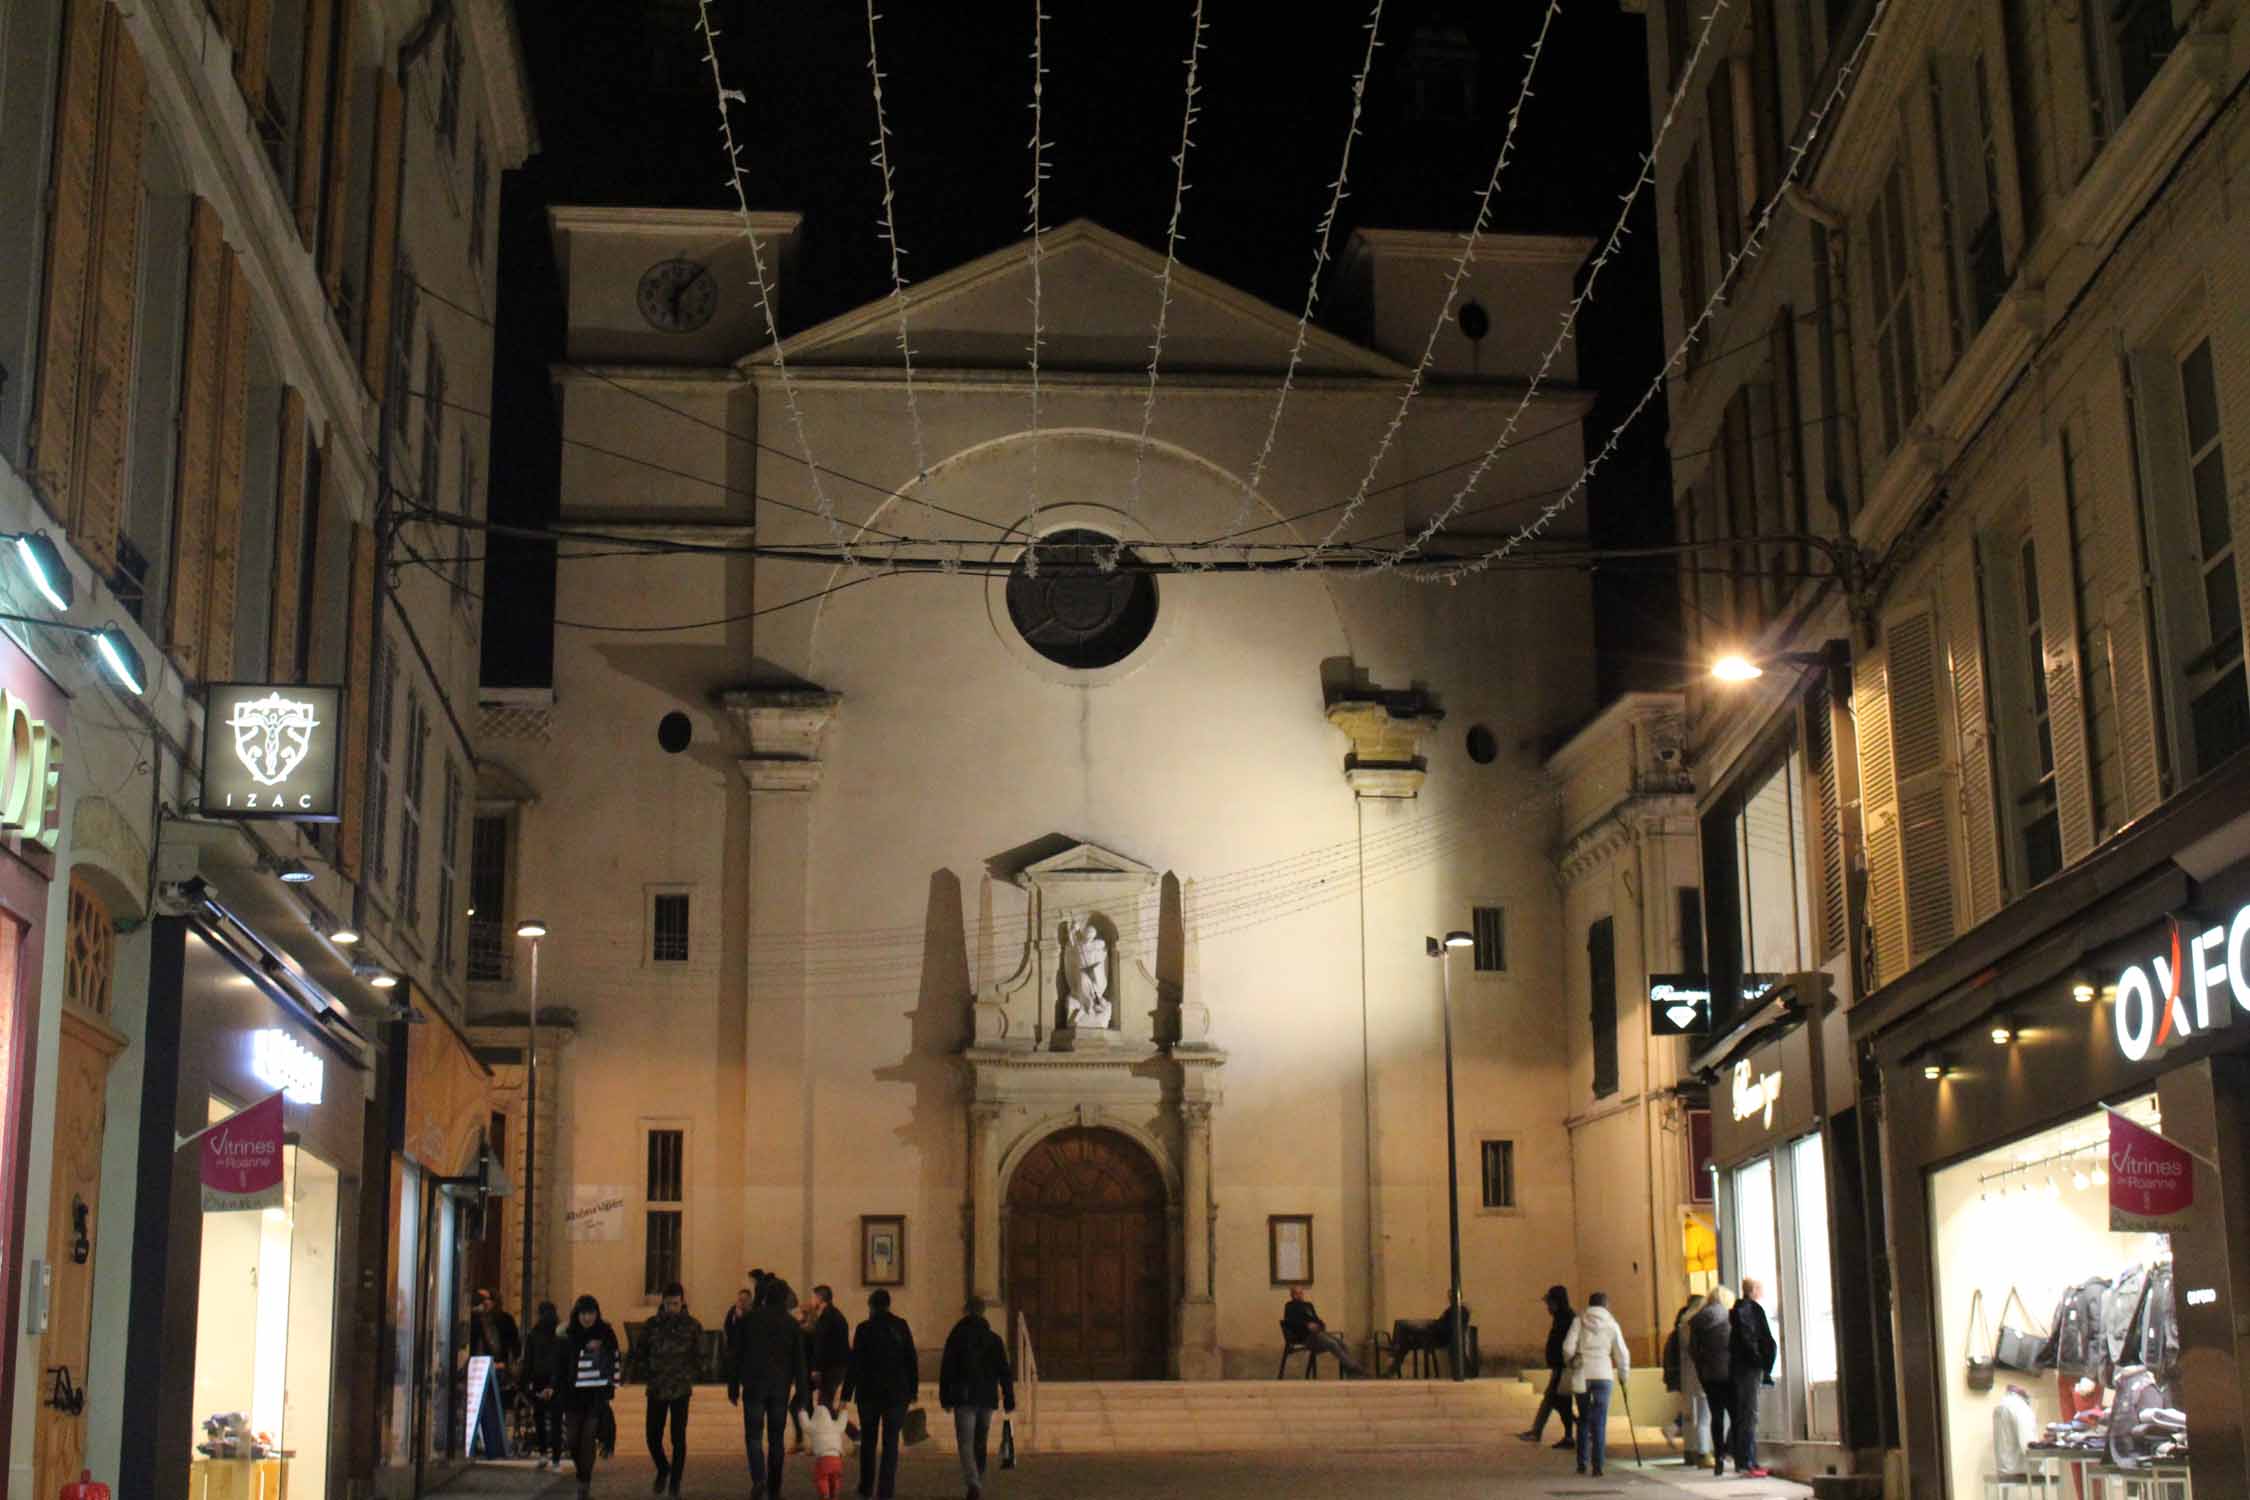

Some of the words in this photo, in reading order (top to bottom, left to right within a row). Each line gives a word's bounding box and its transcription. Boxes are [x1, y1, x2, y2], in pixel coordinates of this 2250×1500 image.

[226, 793, 311, 808] IZAC
[210, 1128, 276, 1155] Vitrines
[2111, 1143, 2182, 1176] Vitrines
